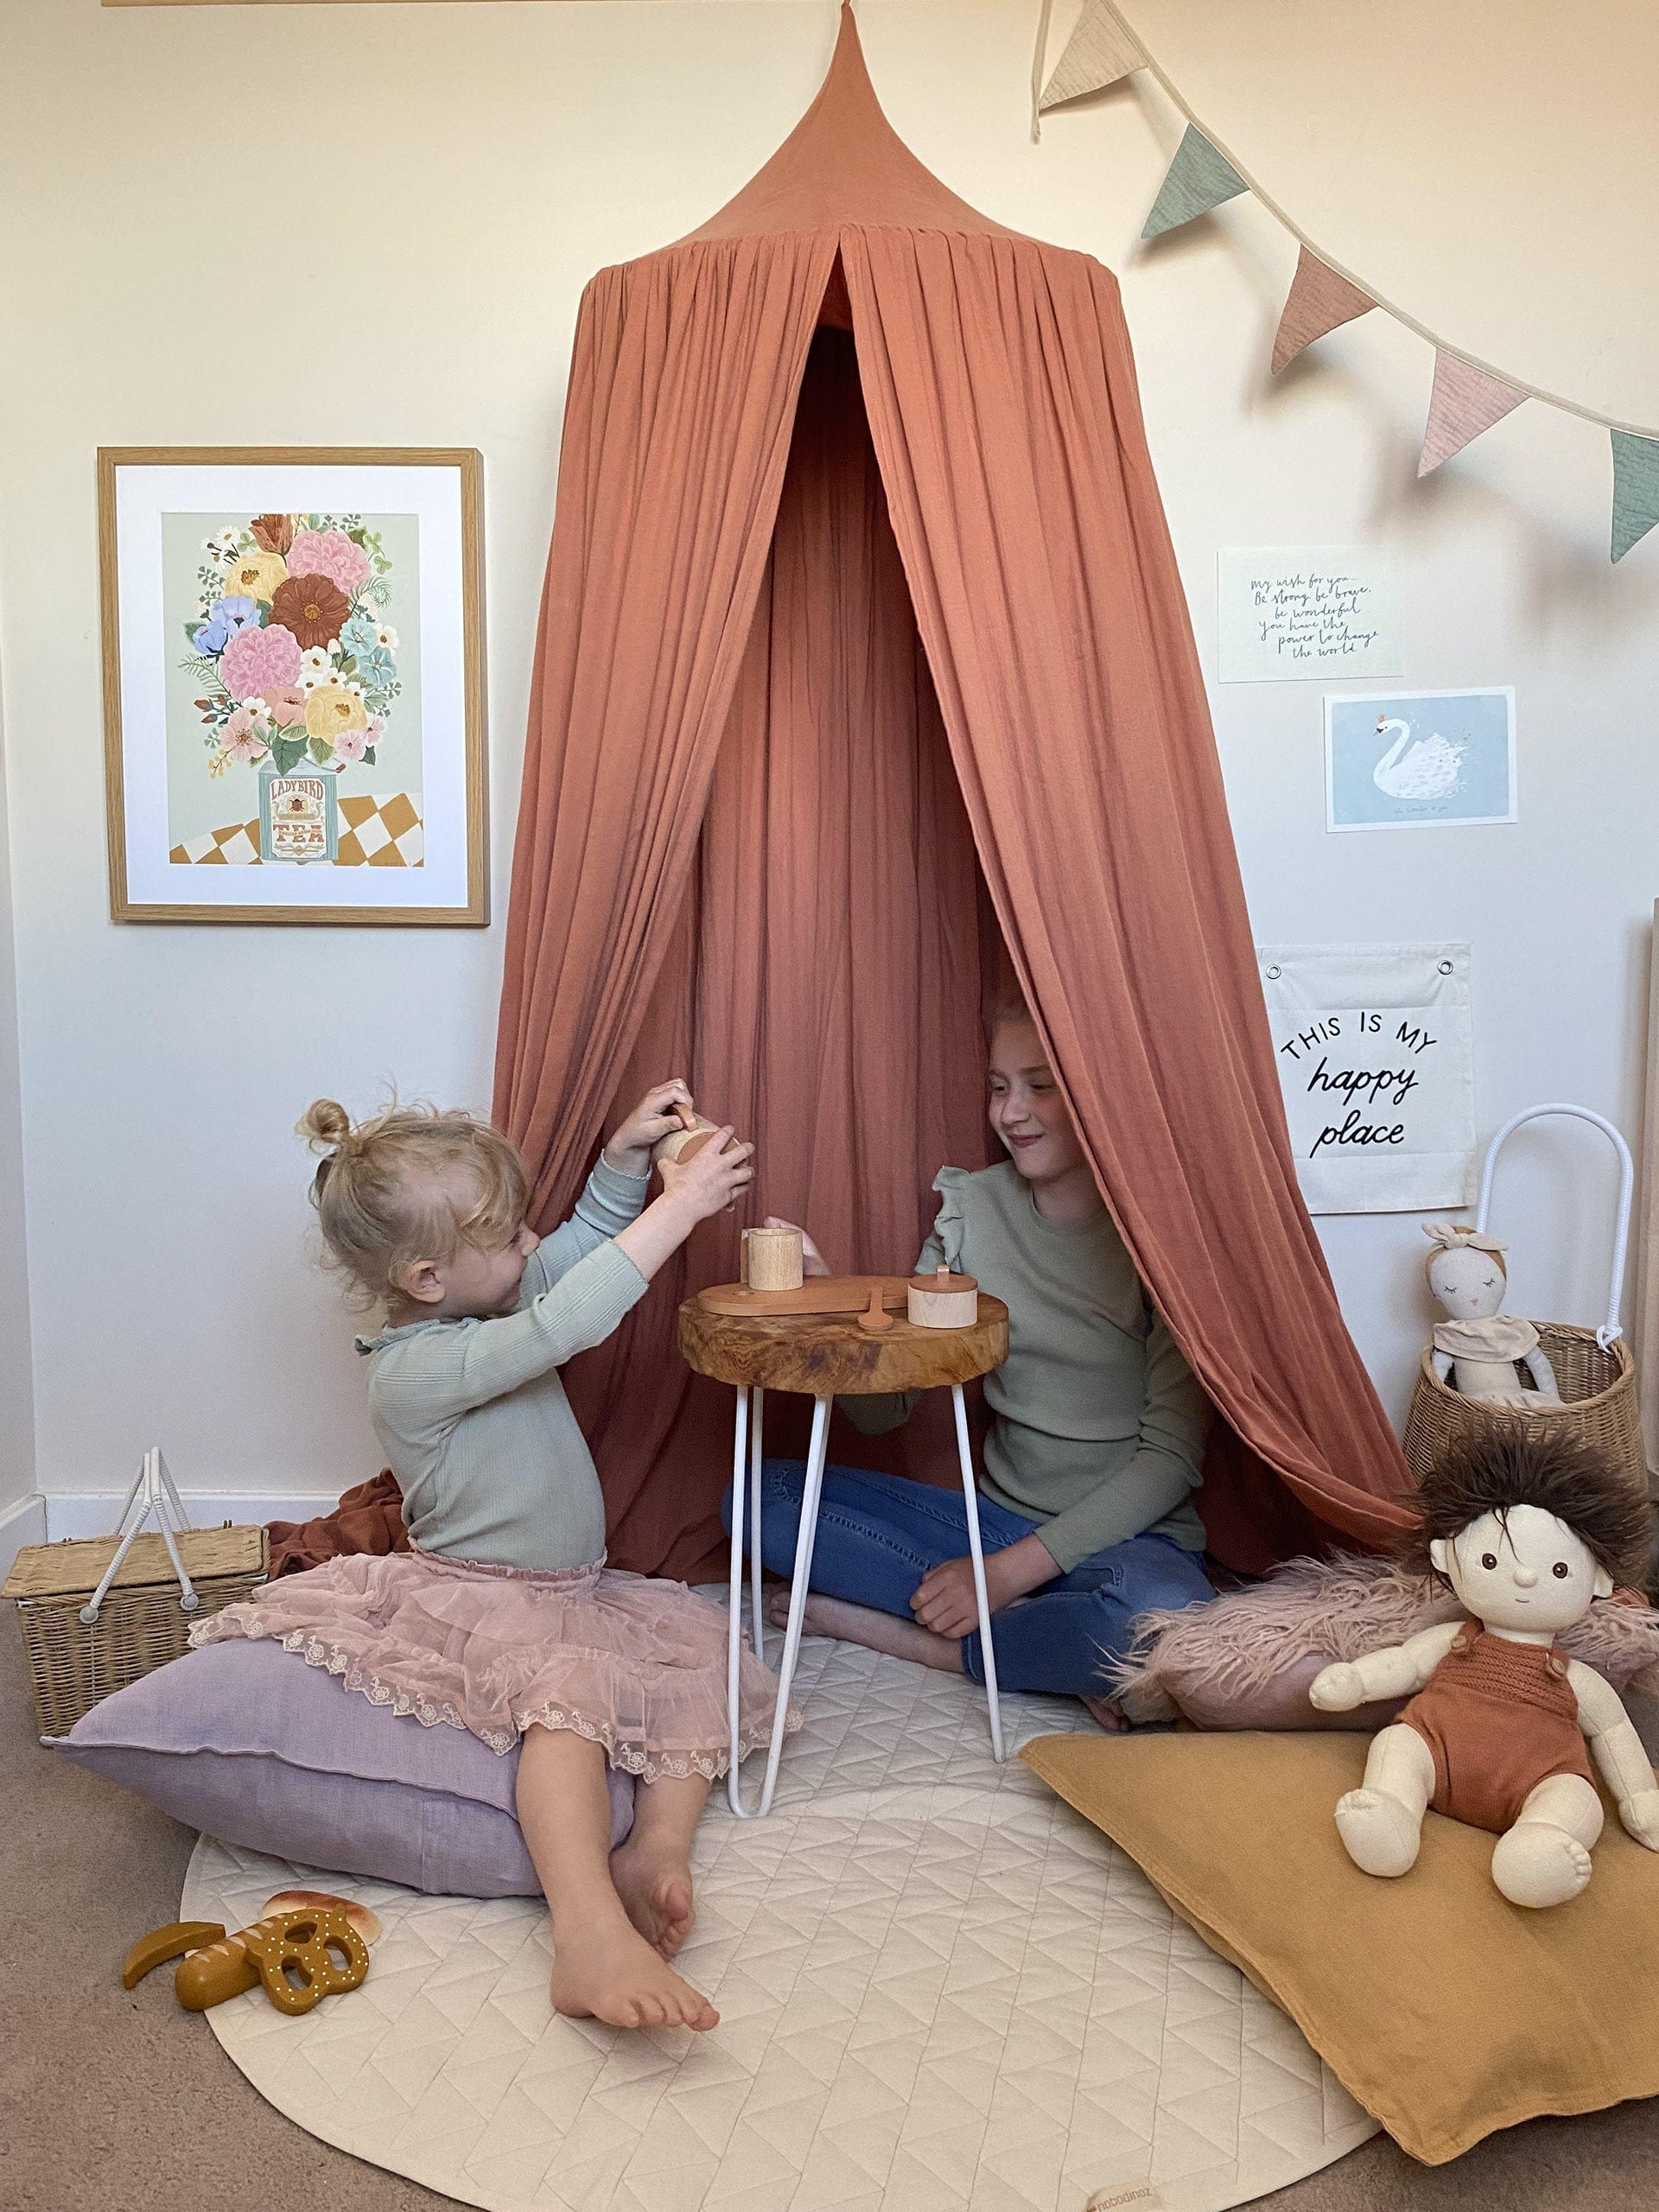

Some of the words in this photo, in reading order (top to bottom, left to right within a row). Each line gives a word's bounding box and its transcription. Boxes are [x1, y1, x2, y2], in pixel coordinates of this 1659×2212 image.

[1276, 574, 1306, 588] wish
[1308, 573, 1324, 588] for
[1255, 591, 1268, 606] Be
[1315, 587, 1328, 602] be
[1274, 607, 1287, 620] be
[1293, 596, 1362, 618] wonderful
[1289, 617, 1319, 631] have
[1323, 616, 1345, 629] the
[1278, 635, 1315, 654] power
[1319, 629, 1333, 645] to
[1337, 625, 1379, 648] change
[1293, 644, 1313, 658] the
[270, 779, 324, 800] LADYBIRD
[273, 824, 324, 842] TEA
[1281, 1017, 1340, 1058] THIS
[1360, 1011, 1382, 1033] IS
[1395, 1021, 1437, 1054] MY
[1306, 1056, 1419, 1106] happy
[1309, 1109, 1404, 1159] place
[1097, 2187, 1153, 2212] nobodinoz
